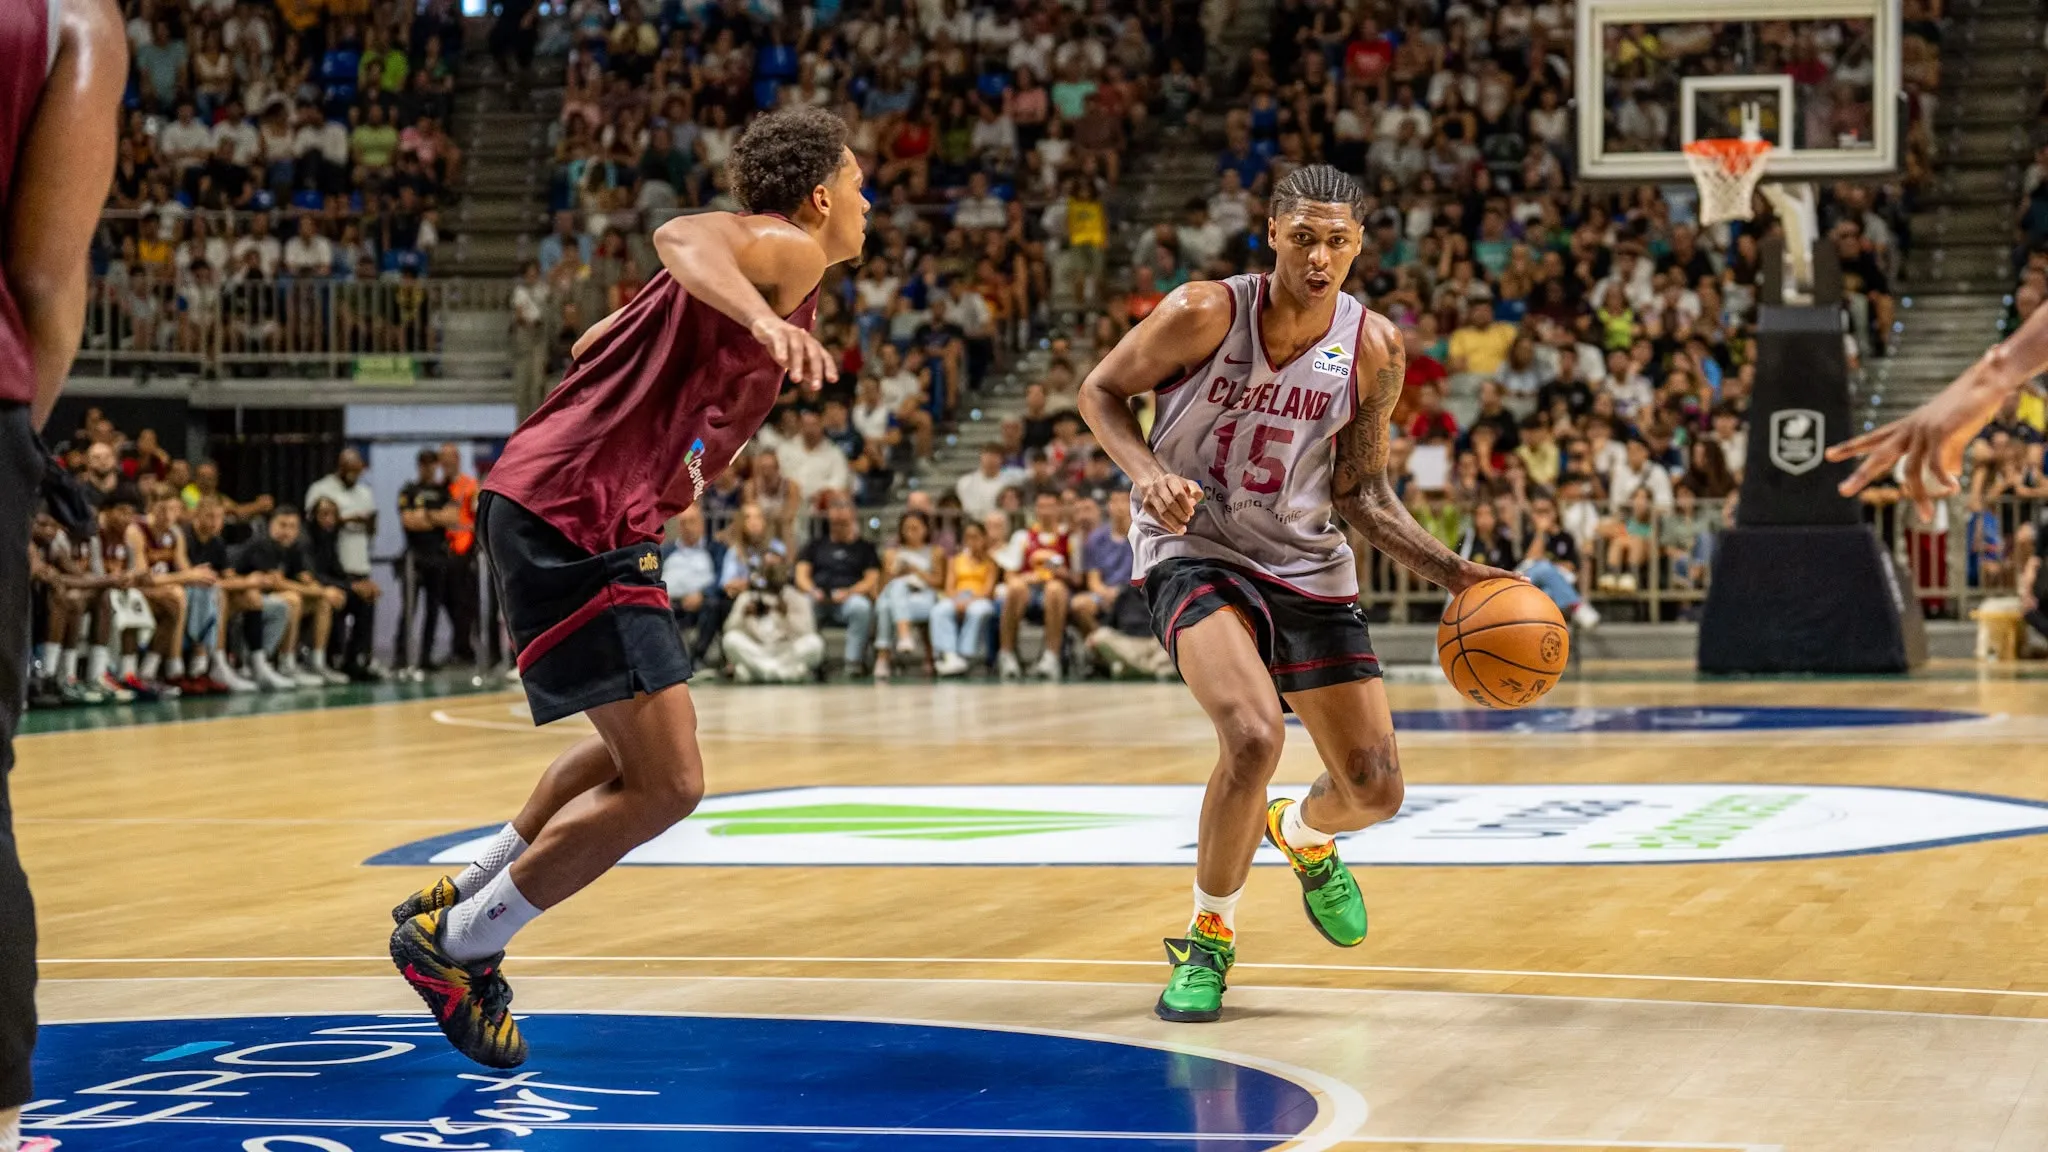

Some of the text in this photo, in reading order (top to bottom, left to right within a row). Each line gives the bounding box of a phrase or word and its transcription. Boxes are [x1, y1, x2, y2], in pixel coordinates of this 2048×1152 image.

[1314, 360, 1349, 376] CLIFFS
[1207, 376, 1332, 421] CLEVELAND
[1208, 420, 1295, 495] 15
